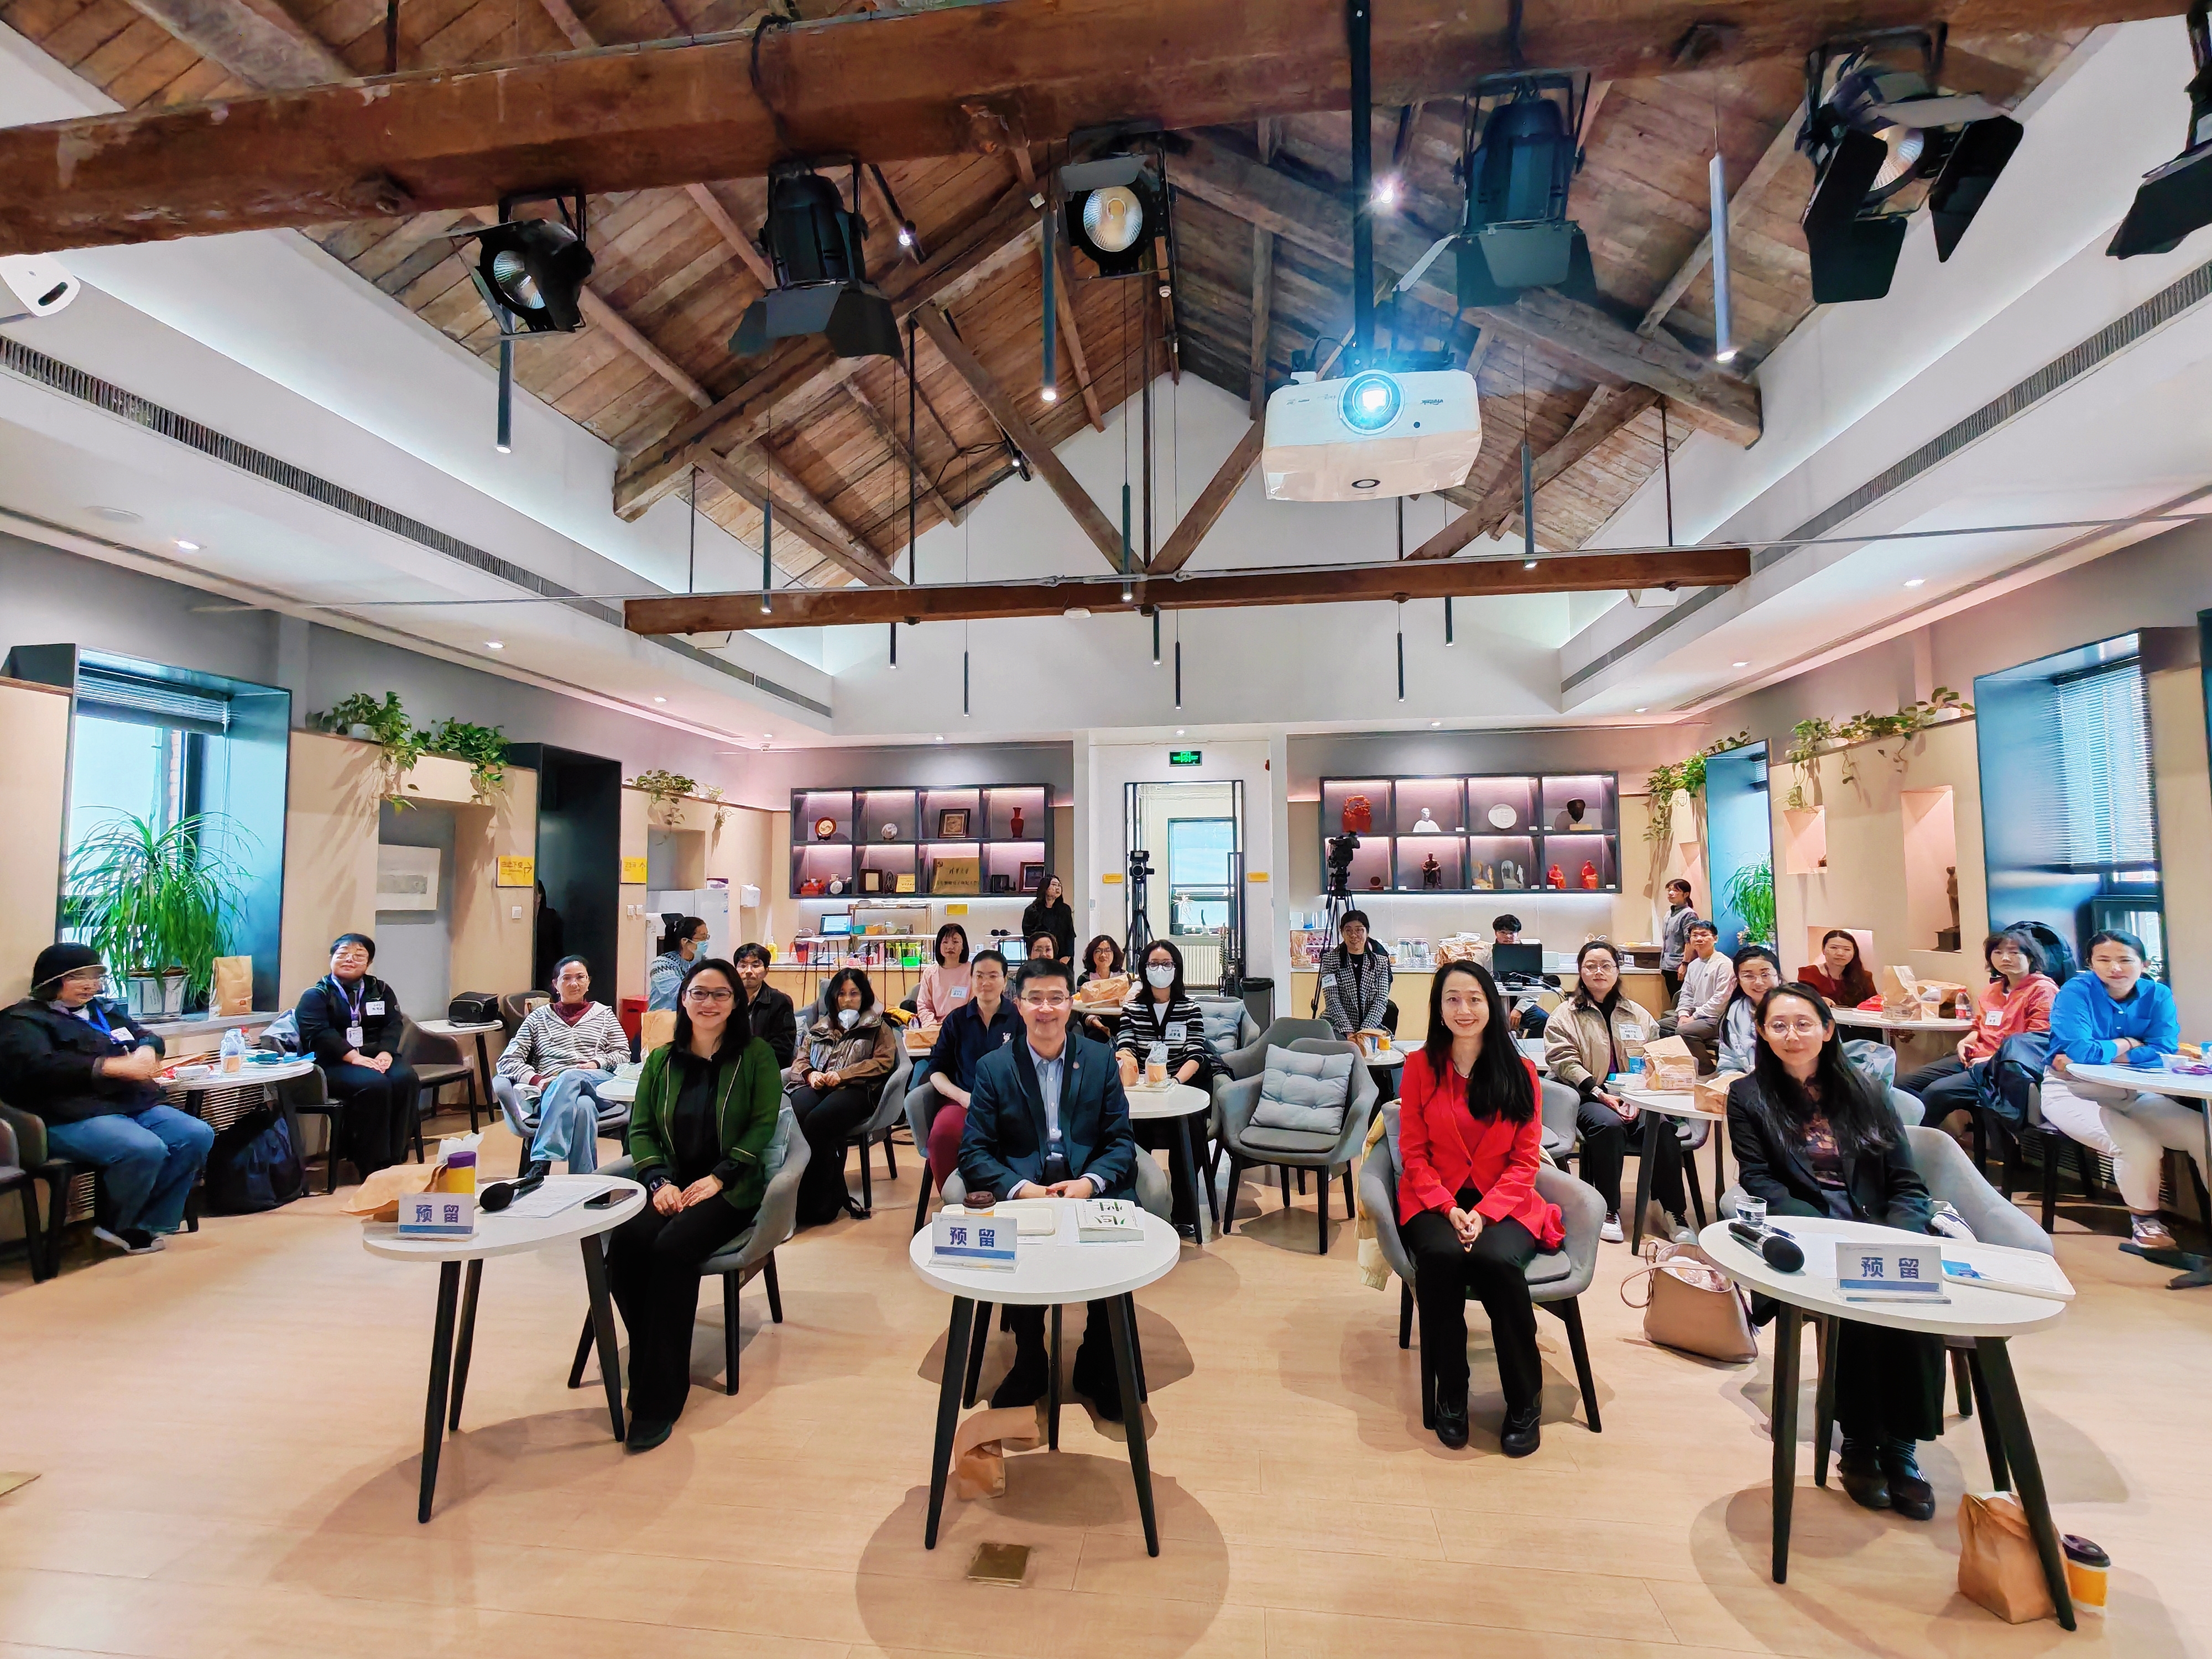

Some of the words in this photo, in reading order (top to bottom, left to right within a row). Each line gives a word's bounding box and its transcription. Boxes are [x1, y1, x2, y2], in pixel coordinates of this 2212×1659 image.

[416, 1204, 458, 1223] 预留
[950, 1227, 995, 1247] 预留
[1861, 1256, 1919, 1279] 预留
